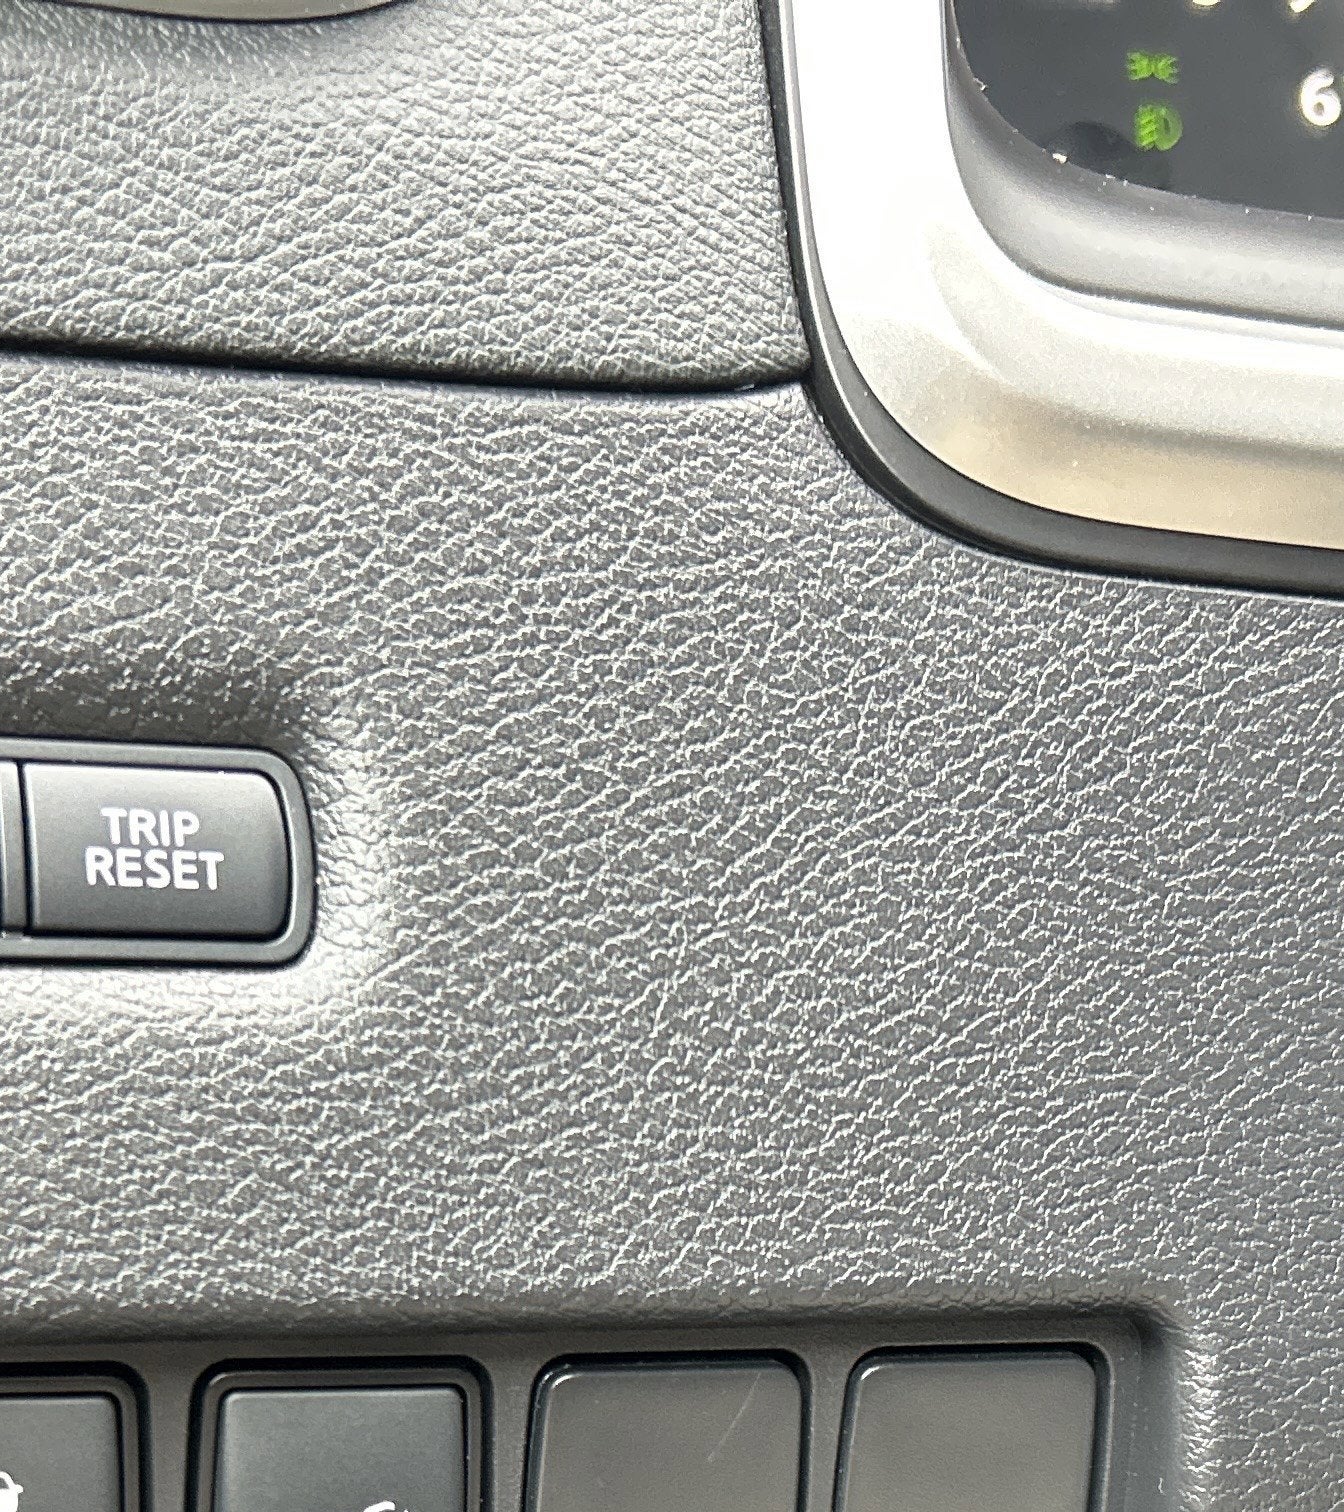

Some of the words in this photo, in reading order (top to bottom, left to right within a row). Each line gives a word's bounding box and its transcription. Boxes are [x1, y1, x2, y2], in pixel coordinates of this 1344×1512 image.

[1299, 66, 1343, 127] 6
[100, 807, 200, 848] TRIP
[84, 846, 225, 891] RESET
